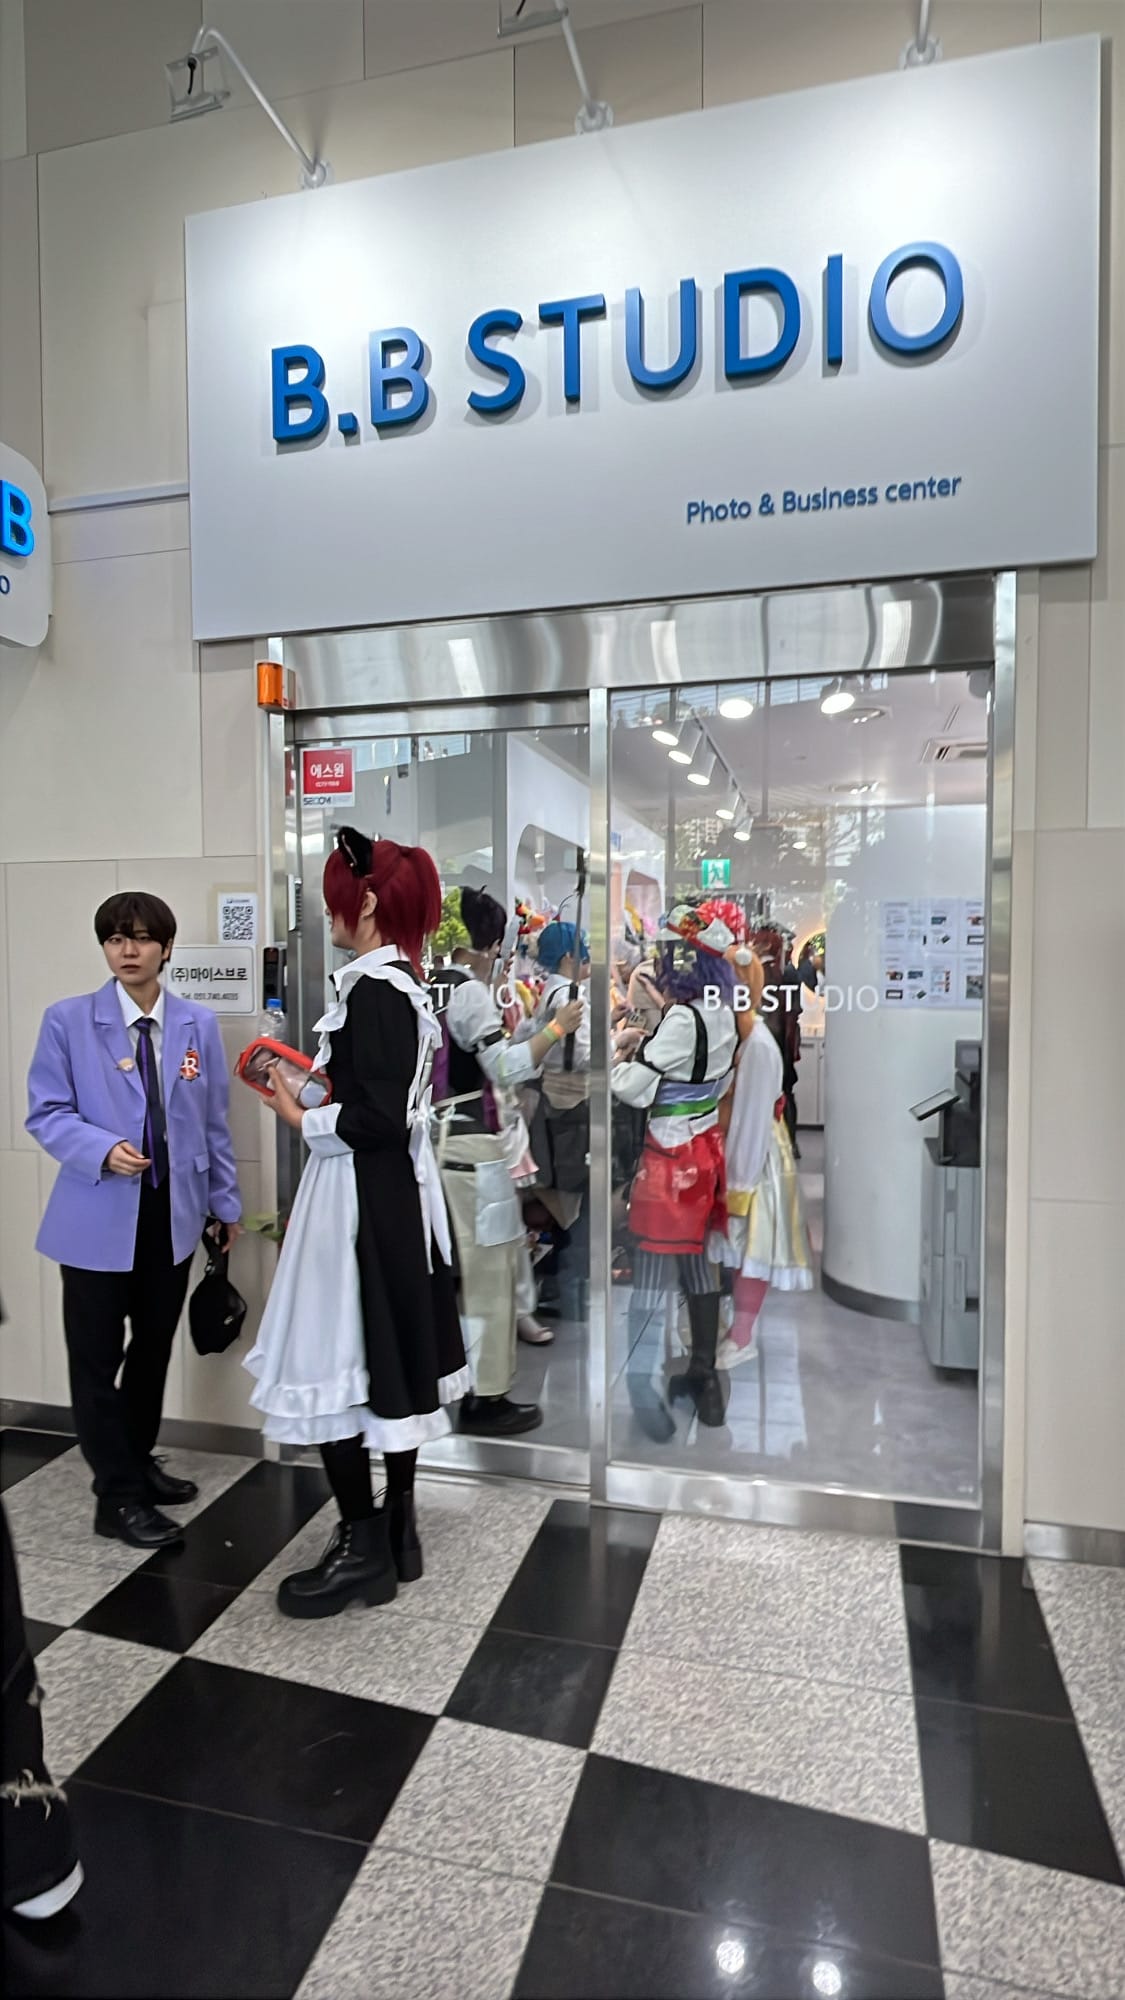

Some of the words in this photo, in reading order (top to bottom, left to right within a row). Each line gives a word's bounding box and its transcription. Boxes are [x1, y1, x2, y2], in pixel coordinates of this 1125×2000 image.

[272, 327, 429, 444] B.B
[466, 241, 965, 412] STUDIO
[686, 498, 751, 524] Photo
[758, 493, 775, 516] &
[782, 486, 878, 514] Business
[885, 476, 962, 502] center
[310, 763, 344, 778] 에스원
[703, 985, 751, 1012] B.B
[761, 984, 880, 1013] STUDIO
